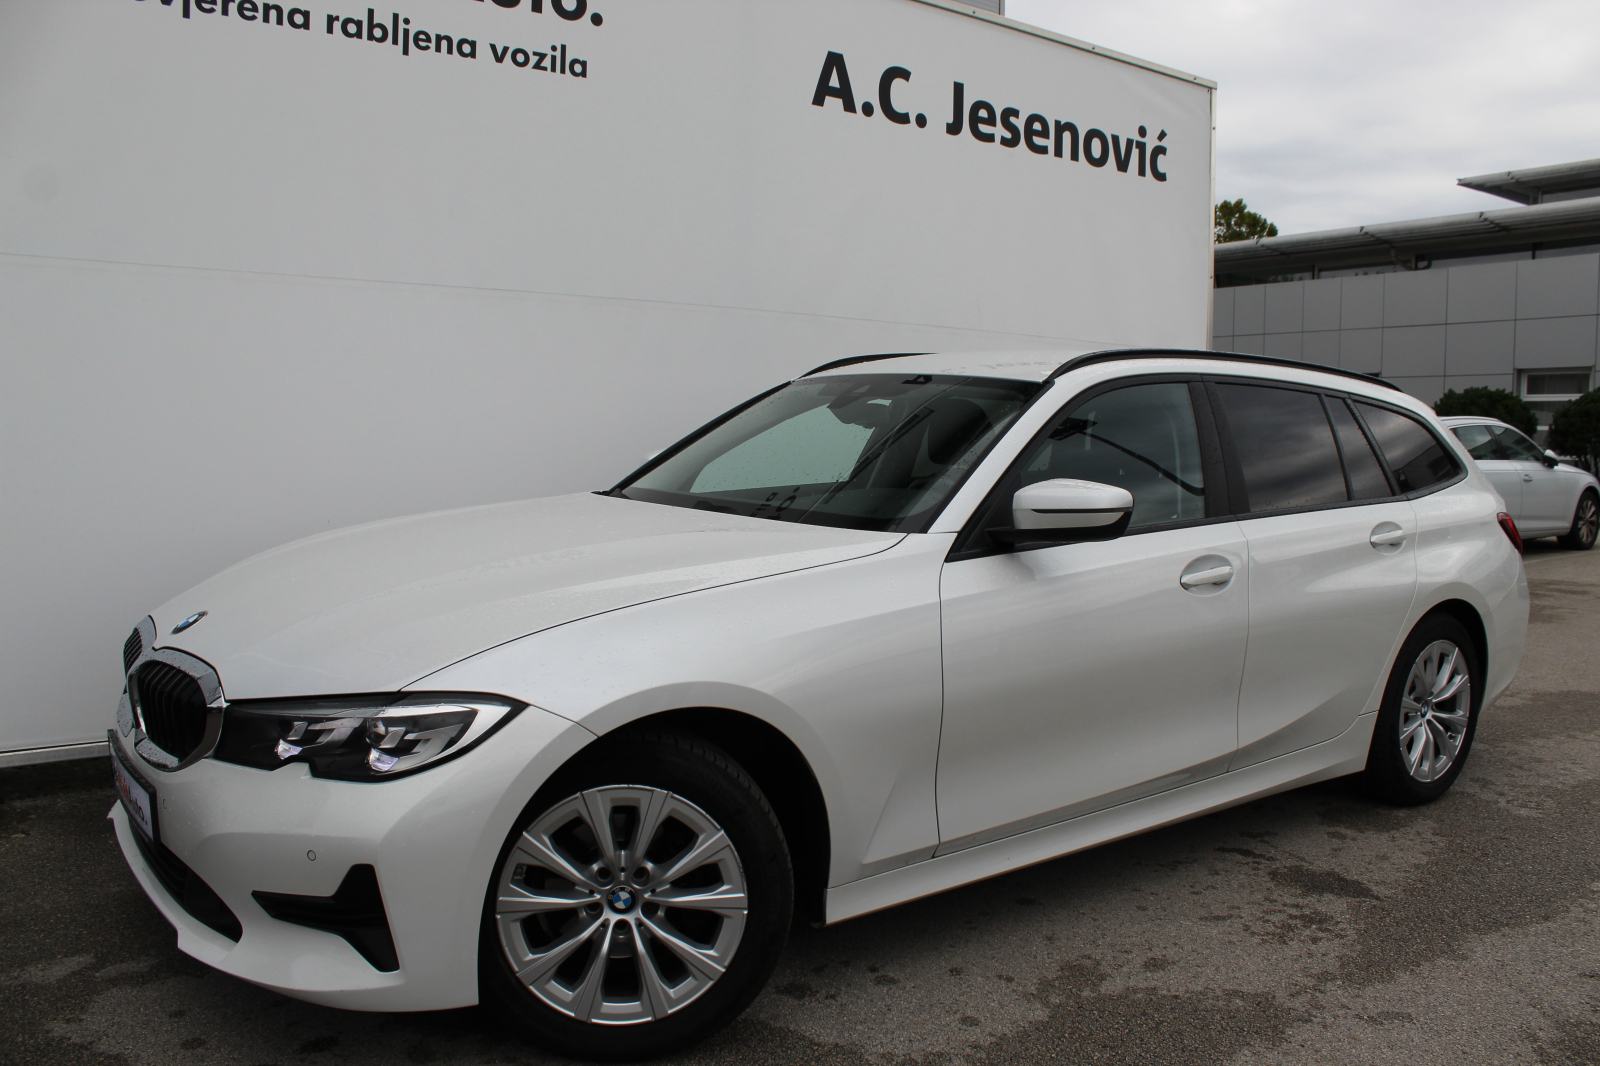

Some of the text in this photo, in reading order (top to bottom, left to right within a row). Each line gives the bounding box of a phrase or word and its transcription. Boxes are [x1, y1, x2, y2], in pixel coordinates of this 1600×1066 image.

[326, 8, 477, 59] rabljena
[489, 43, 588, 79] vozila
[811, 50, 1168, 183] A.C. Jesenović
